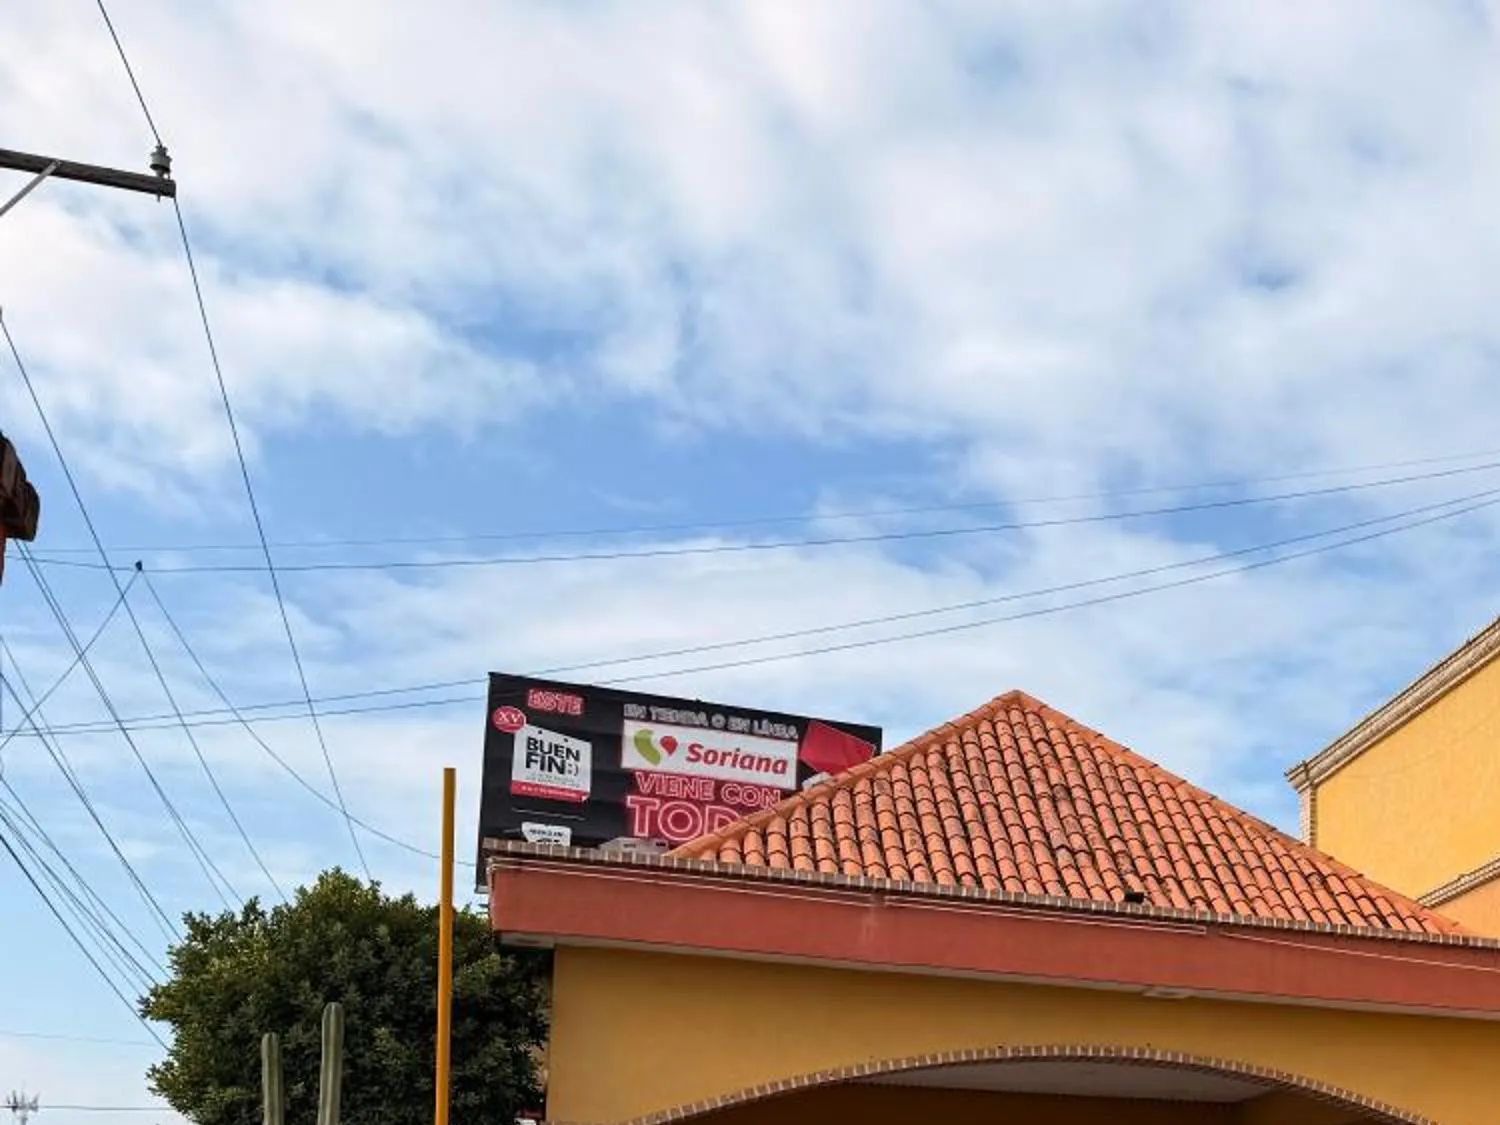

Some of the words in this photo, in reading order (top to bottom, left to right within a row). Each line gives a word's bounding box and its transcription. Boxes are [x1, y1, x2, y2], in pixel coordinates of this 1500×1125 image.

[499, 710, 522, 724] XV
[623, 703, 647, 718] EN
[650, 706, 709, 727] TIENDA
[711, 713, 726, 729] O
[727, 716, 750, 732] EN
[526, 736, 581, 763] BUEN
[685, 742, 789, 775] Soriana
[635, 771, 716, 801] VIENE
[720, 783, 782, 809] CON
[626, 795, 741, 842] TOD
